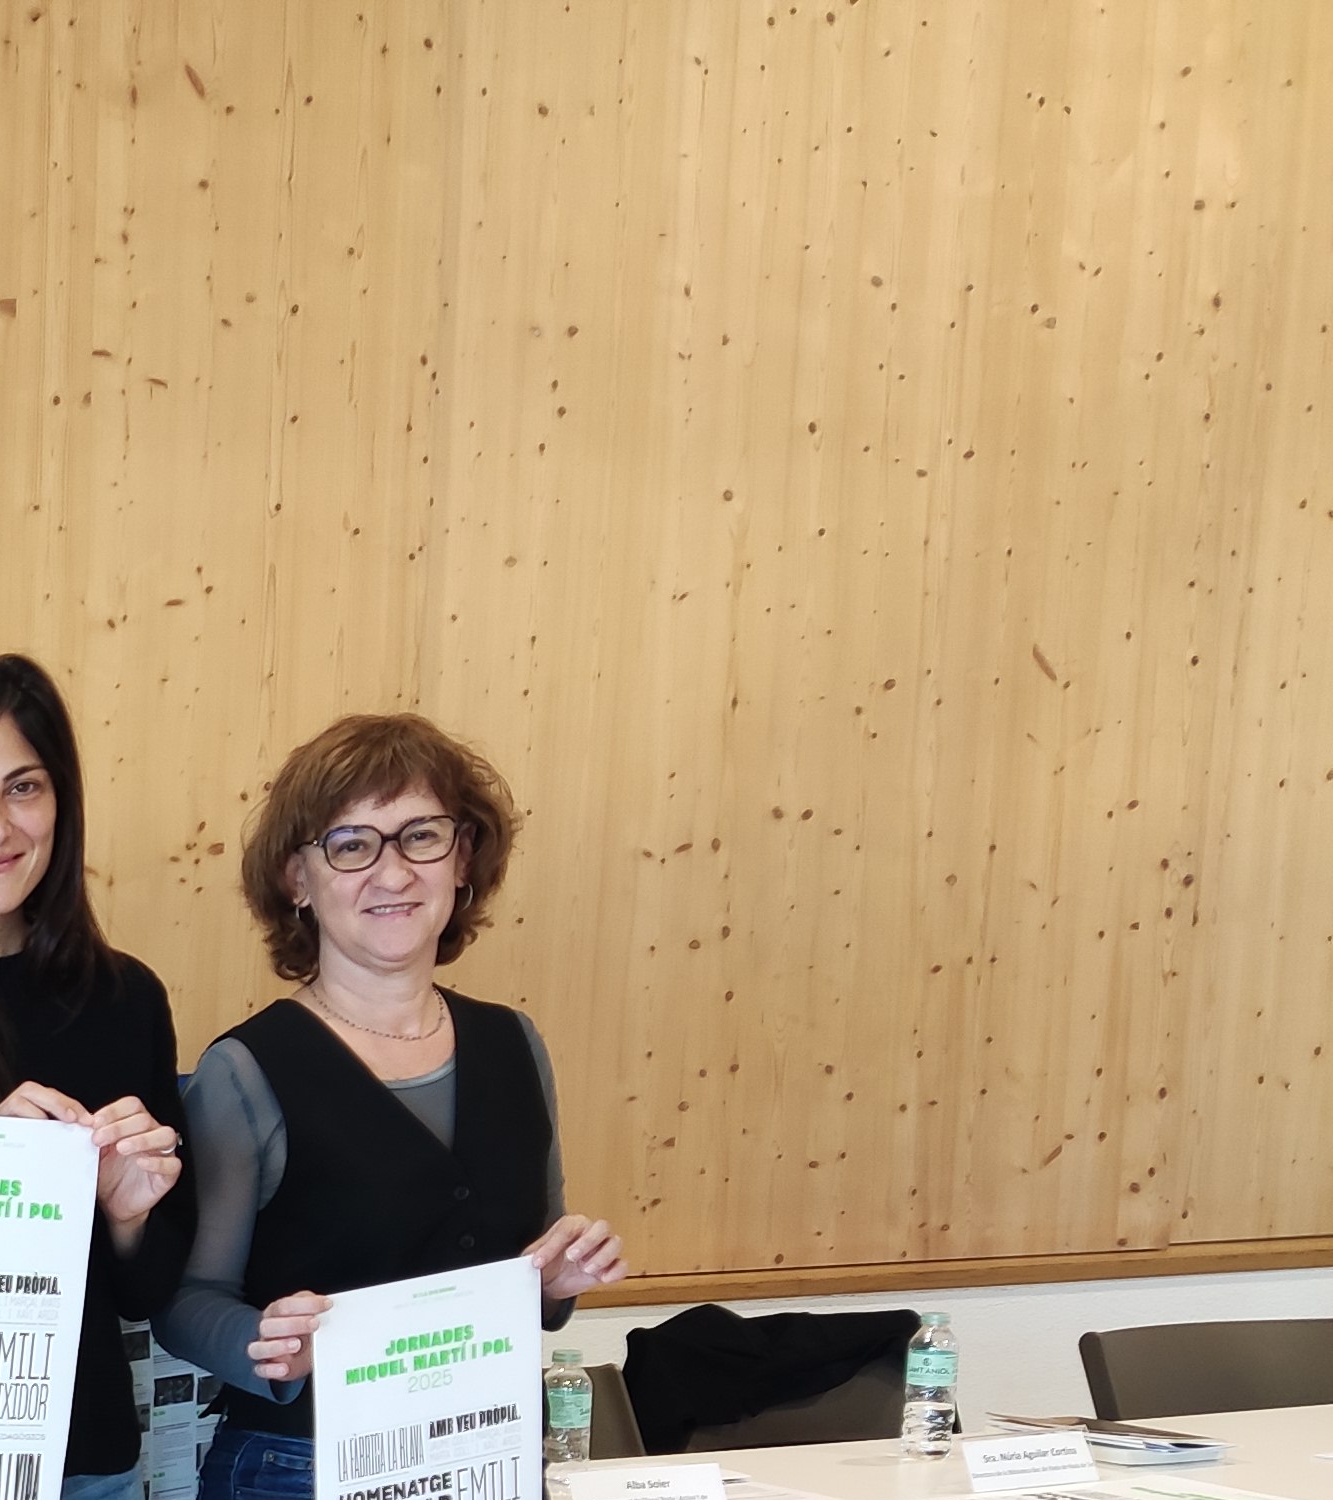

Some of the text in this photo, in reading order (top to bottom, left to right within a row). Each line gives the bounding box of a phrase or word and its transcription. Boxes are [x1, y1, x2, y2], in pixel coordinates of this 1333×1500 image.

[18, 1203, 23, 1218] I
[30, 1203, 62, 1221] POL
[386, 1324, 474, 1356] JORNADES
[346, 1337, 513, 1385] MIQUEL MARTÍ I POL
[408, 1369, 453, 1393] 2025
